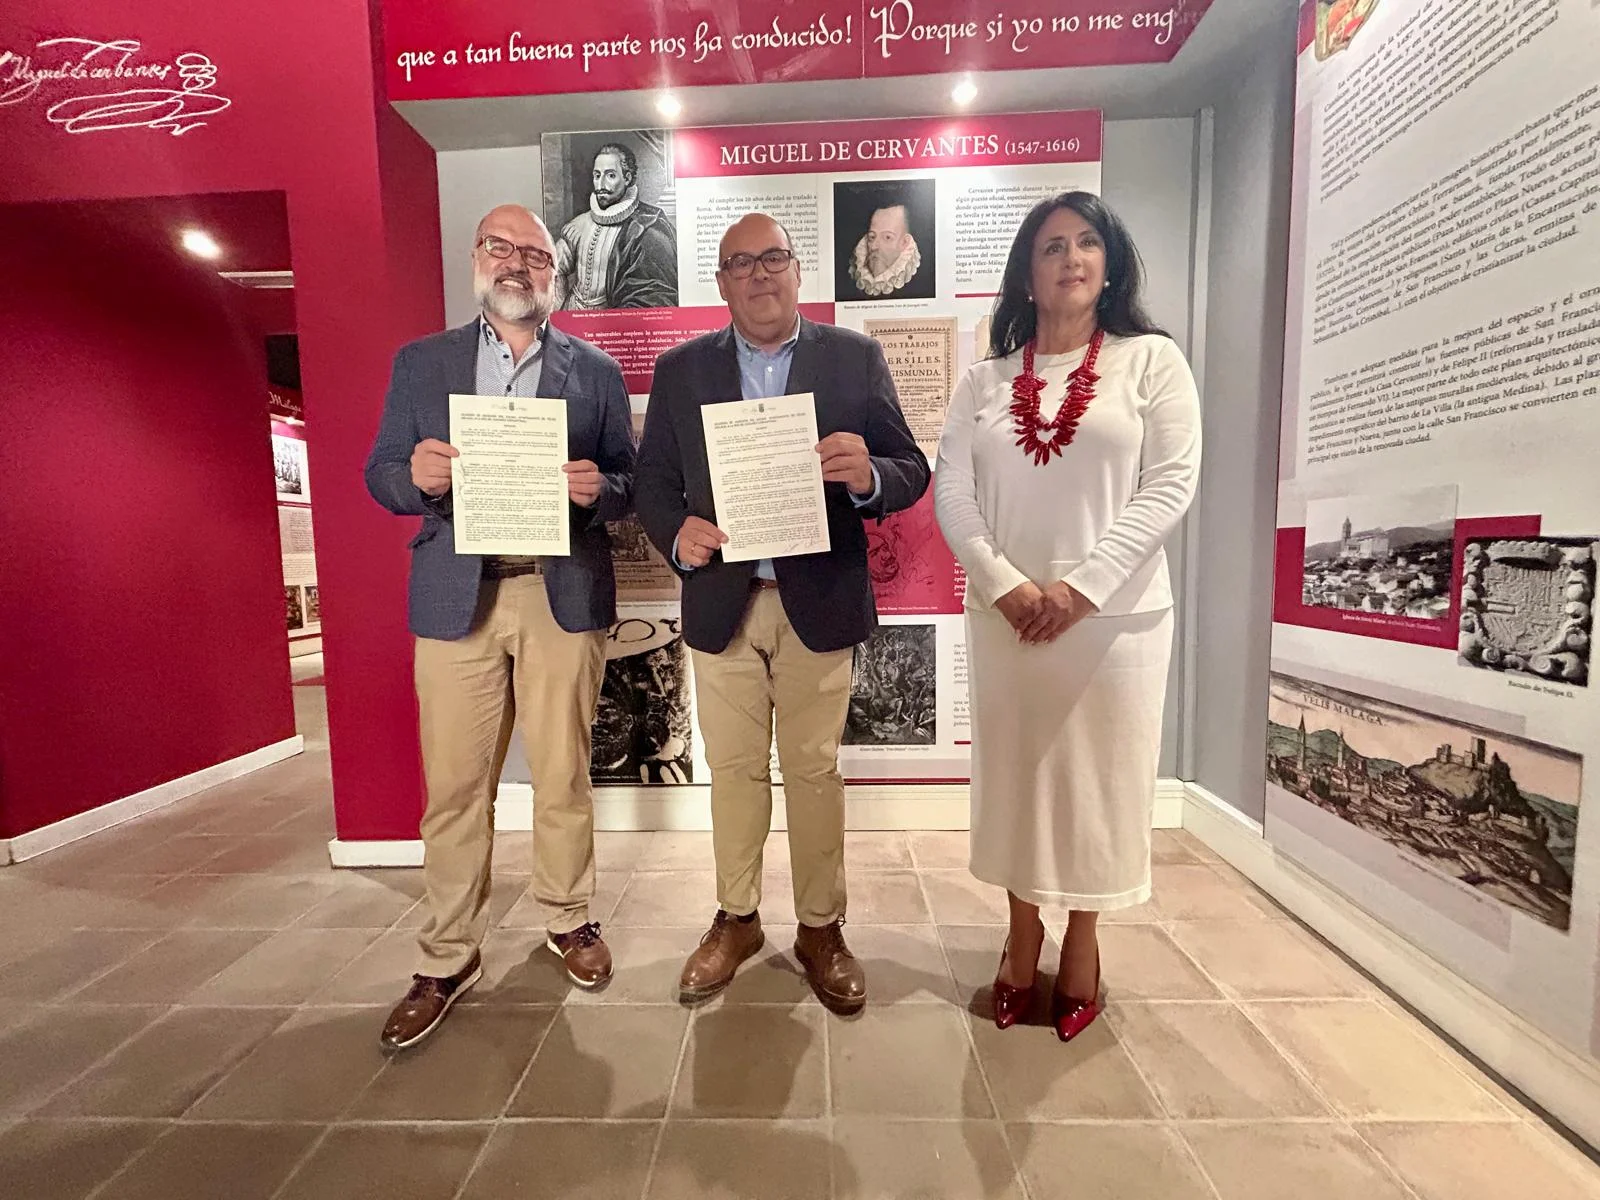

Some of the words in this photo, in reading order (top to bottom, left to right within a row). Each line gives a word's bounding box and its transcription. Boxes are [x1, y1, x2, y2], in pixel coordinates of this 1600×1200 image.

[870, 0, 978, 58] Porque
[986, 13, 1004, 42] si
[1012, 14, 1043, 53] yo
[1051, 16, 1080, 34] no
[1088, 11, 1124, 32] me
[397, 51, 436, 82] que
[443, 50, 458, 65] a
[466, 43, 502, 64] tan
[509, 31, 574, 62] buena
[582, 33, 641, 73] parte
[650, 36, 686, 58] nos
[693, 22, 723, 64] ha
[731, 13, 852, 50] conducido!
[1553, 98, 1574, 120] que
[1577, 85, 1597, 103] nos
[720, 144, 814, 166] MIGUEL
[818, 142, 851, 162] DE
[856, 134, 999, 160] CERVANTES
[1004, 137, 1081, 156] (1547-1616)
[1522, 135, 1538, 153] por
[1520, 162, 1546, 181] Todo
[1582, 202, 1596, 214] de
[1499, 226, 1509, 236] de
[1514, 220, 1522, 229] la
[1527, 244, 1534, 254] la
[1421, 342, 1437, 354] para
[1454, 326, 1482, 341] mejora
[1488, 318, 1501, 330] del
[1508, 306, 1543, 323] espacio
[1551, 301, 1556, 312] y
[1563, 293, 1572, 305] el
[1440, 345, 1468, 359] fuentes
[1474, 332, 1510, 351] públicas
[1517, 325, 1528, 335] de
[1535, 318, 1553, 329] San
[888, 356, 940, 364] ERSILES,
[1440, 364, 1449, 372] de
[1452, 357, 1477, 369] Felipe
[1490, 336, 1544, 360] (reformada
[1548, 334, 1553, 344] y
[1402, 385, 1424, 395] mayor
[1426, 379, 1446, 392] parte
[1448, 375, 1457, 383] de
[1460, 369, 1479, 380] todo
[1482, 365, 1498, 374] este
[1501, 358, 1521, 372] plan
[1406, 395, 1436, 407] antiguas
[1439, 385, 1473, 398] murallas
[1476, 372, 1528, 389] medievales,
[1533, 360, 1568, 376] debido
[1573, 355, 1581, 366] al
[1377, 417, 1385, 425] del
[1388, 413, 1408, 423] barrio
[1434, 403, 1451, 413] Villa
[1454, 400, 1464, 410] (la
[1467, 393, 1499, 405] antigua
[1503, 380, 1546, 397] Medina).
[1554, 376, 1572, 386] Las
[1426, 418, 1443, 427] calle
[1446, 415, 1460, 423] San
[1464, 406, 1505, 420] Francisco
[1522, 391, 1578, 408] convierten
[1583, 387, 1596, 395] en
[1405, 433, 1430, 444] ciudad.
